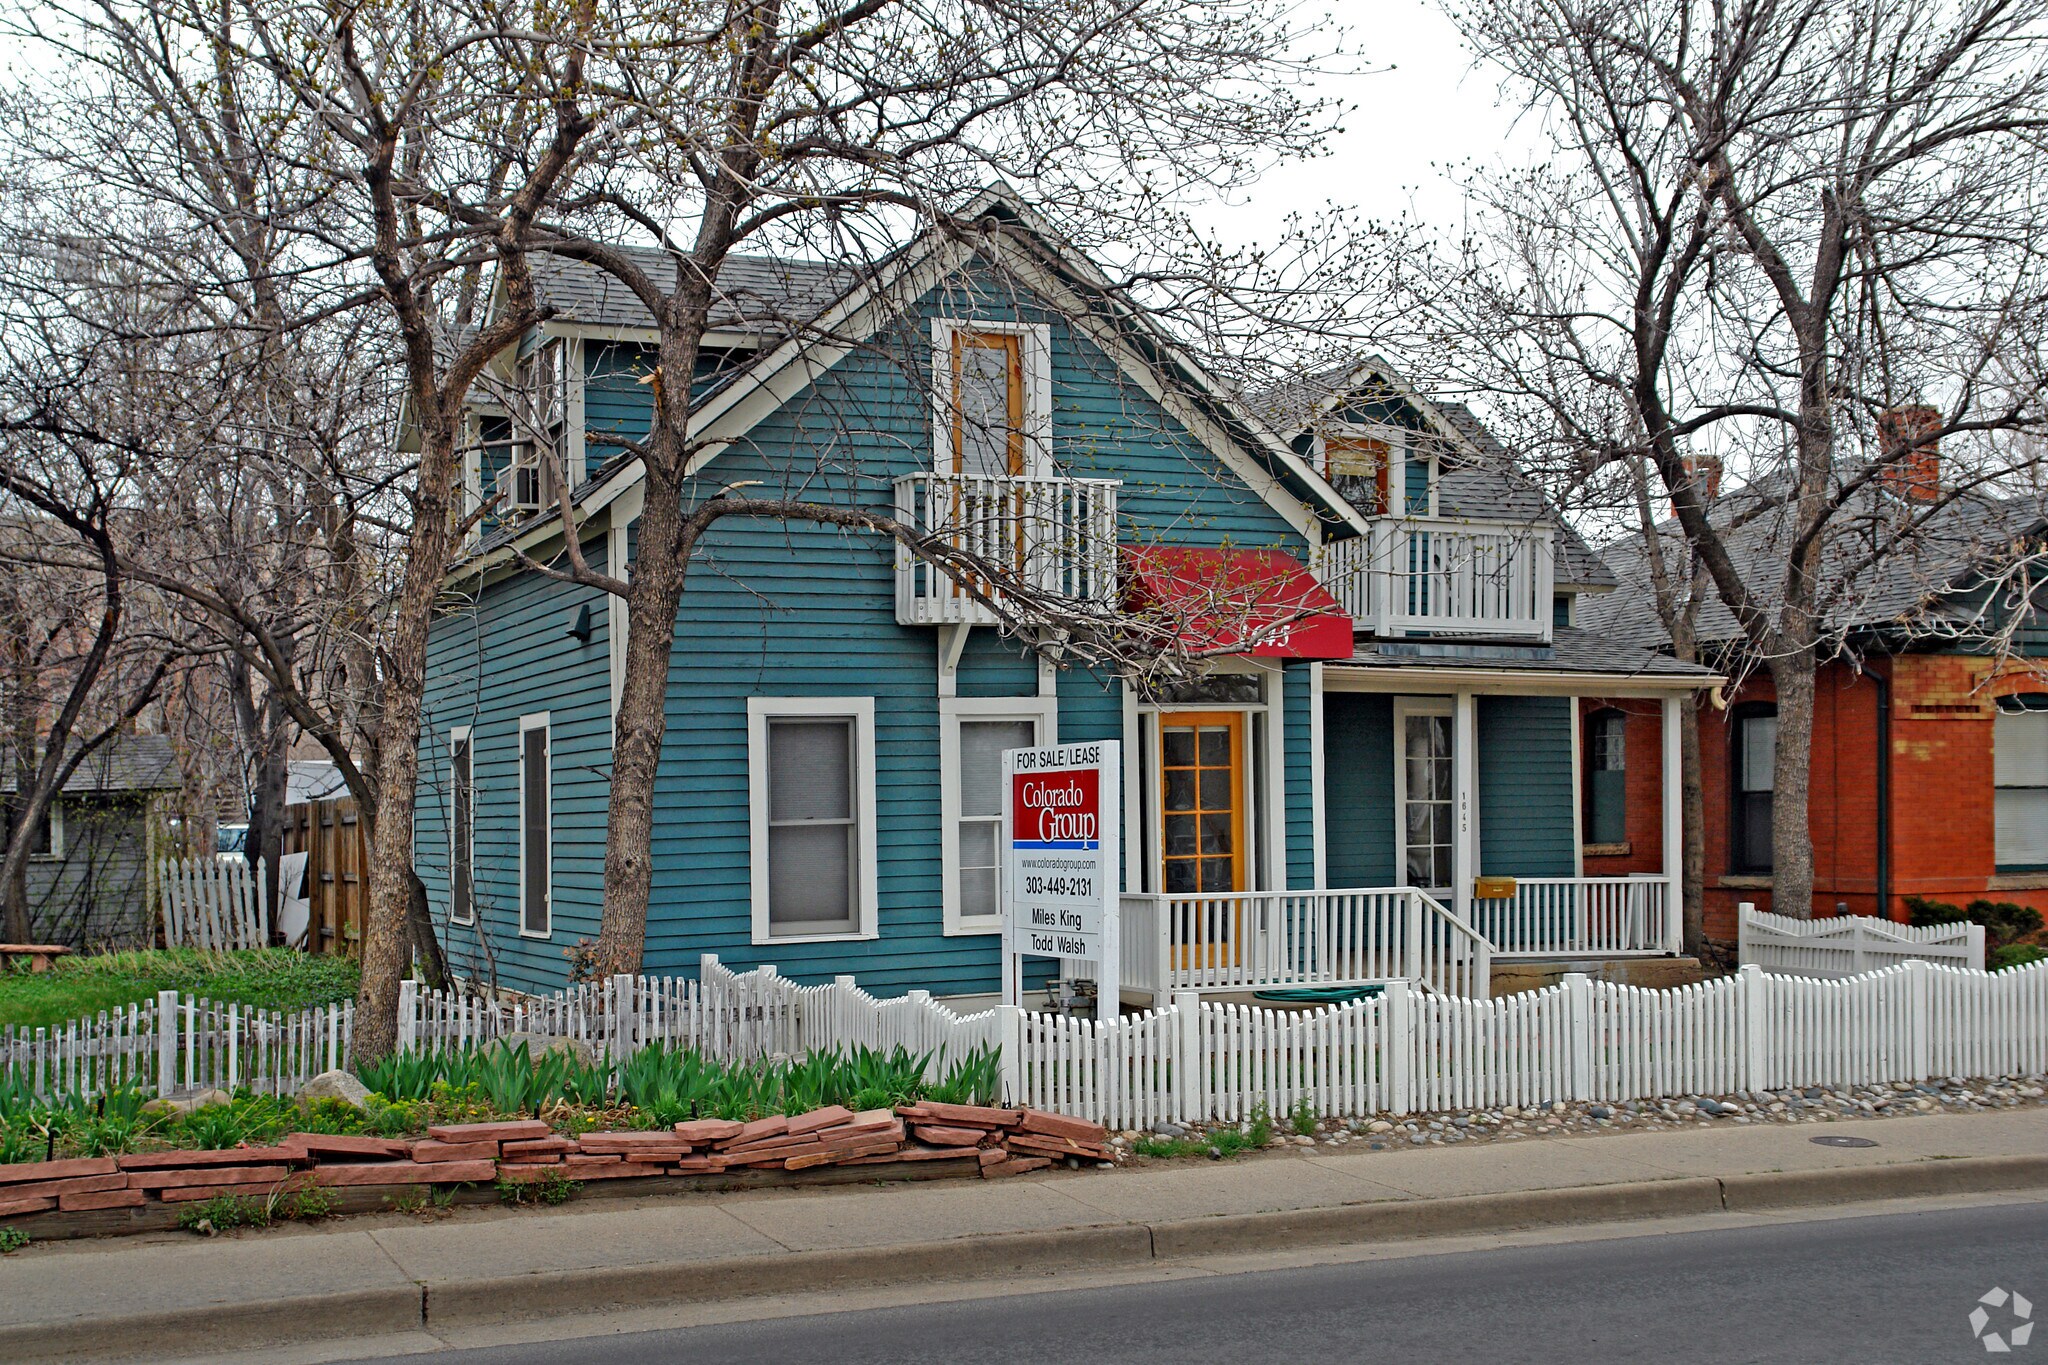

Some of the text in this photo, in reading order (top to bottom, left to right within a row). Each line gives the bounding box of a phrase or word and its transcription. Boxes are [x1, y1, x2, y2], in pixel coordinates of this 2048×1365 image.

[1017, 746, 1099, 769] FOR SALE/LEASE
[1023, 779, 1083, 808] Colorado
[1038, 807, 1096, 850] Group
[1021, 857, 1096, 872] www.coloradogroup.com
[1025, 876, 1092, 896] 303-449-2131
[1032, 908, 1082, 931] Miles King
[1031, 933, 1086, 955] Todd Walsh
